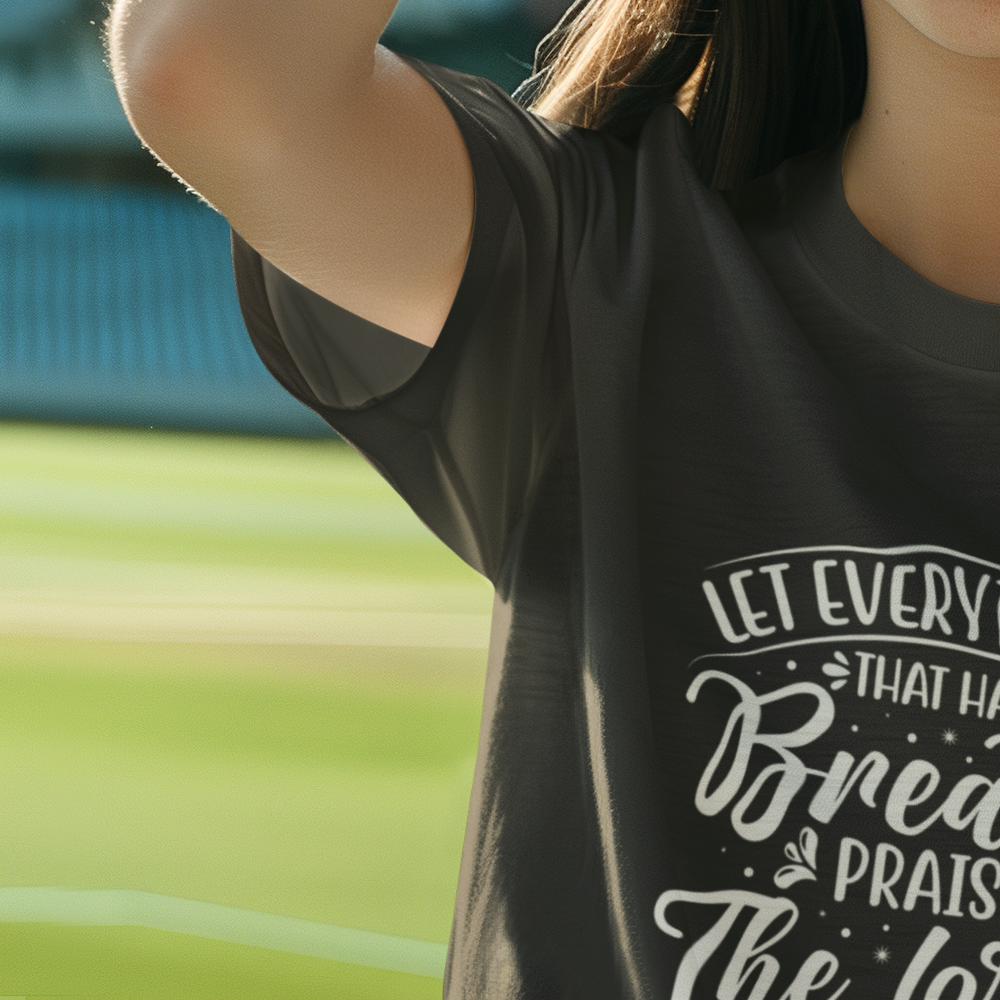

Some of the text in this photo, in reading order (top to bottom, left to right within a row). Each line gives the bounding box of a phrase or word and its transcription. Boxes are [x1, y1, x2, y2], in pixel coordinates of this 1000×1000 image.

[702, 562, 795, 644] LET
[854, 650, 951, 711] THAT
[653, 888, 851, 1000] The
